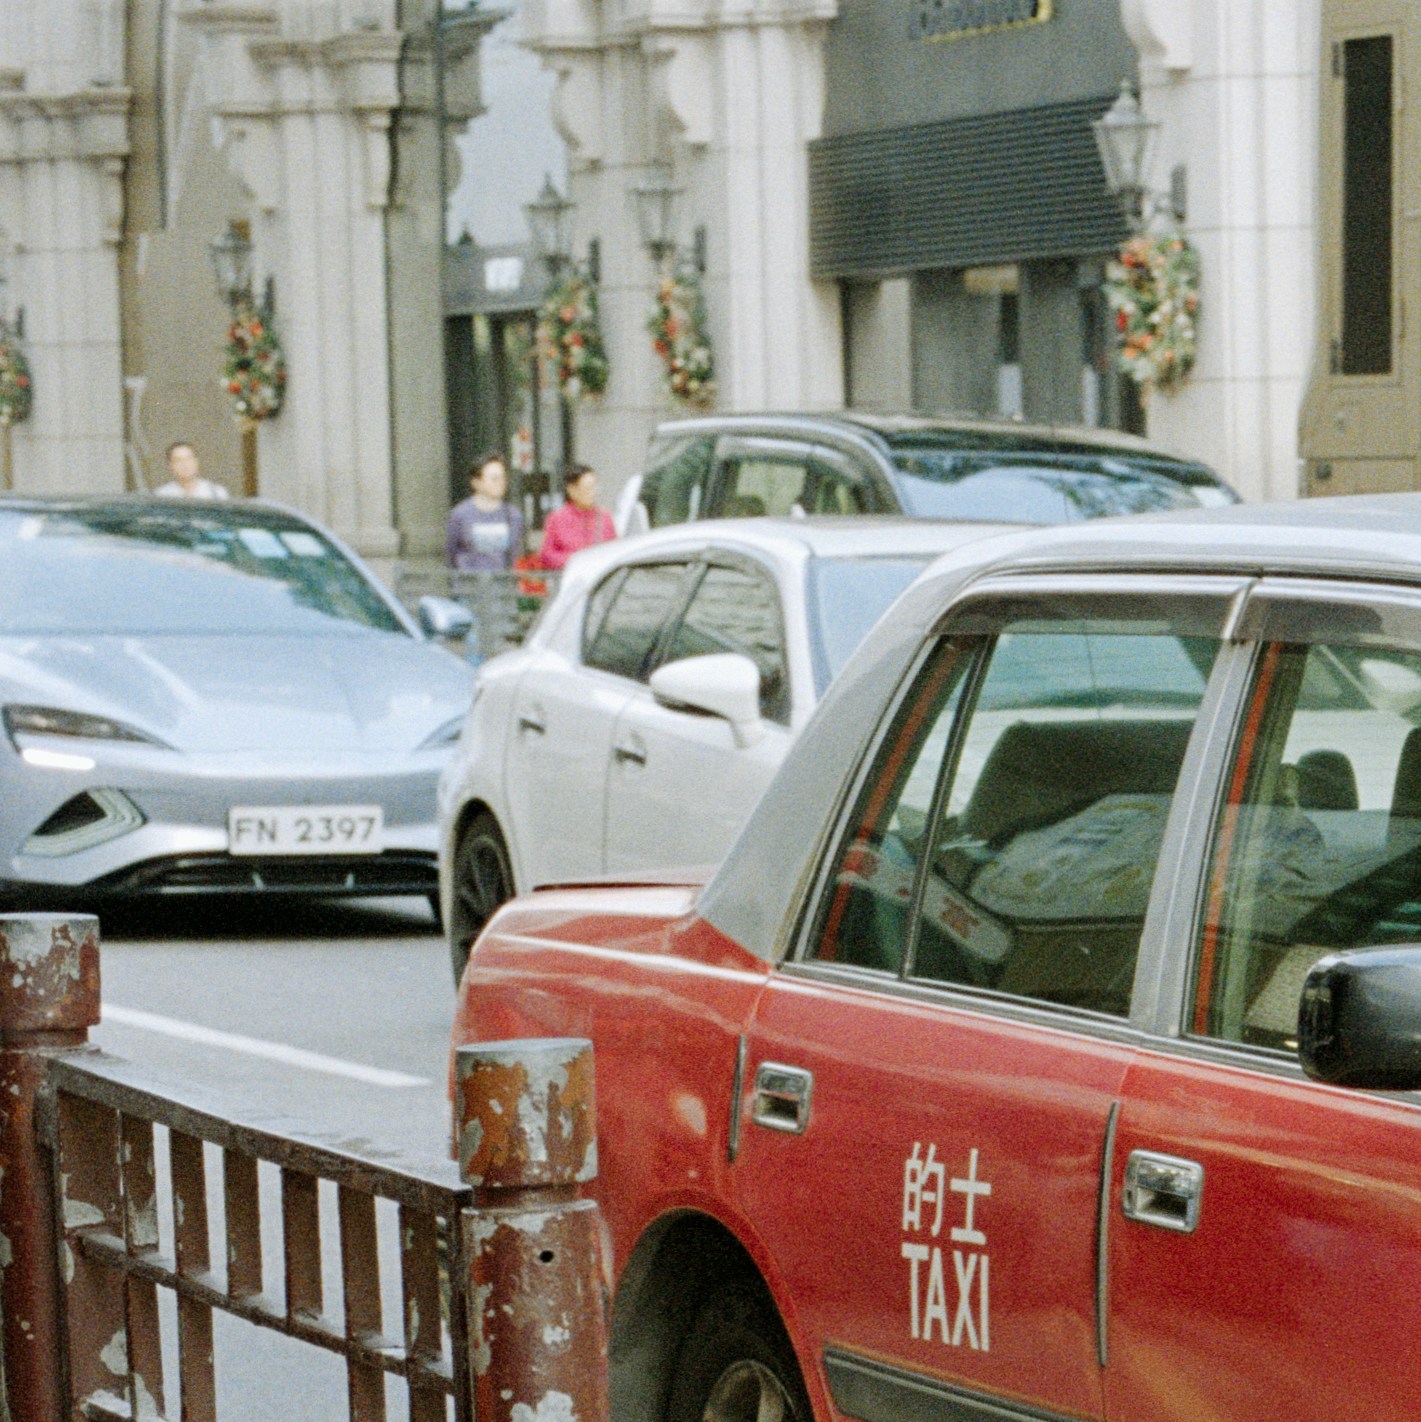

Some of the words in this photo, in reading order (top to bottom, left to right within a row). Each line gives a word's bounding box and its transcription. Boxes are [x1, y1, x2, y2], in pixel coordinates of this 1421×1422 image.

[235, 817, 277, 841] FN
[295, 815, 377, 842] 2397
[902, 1141, 993, 1246] 的士
[901, 1242, 990, 1352] TAXI
